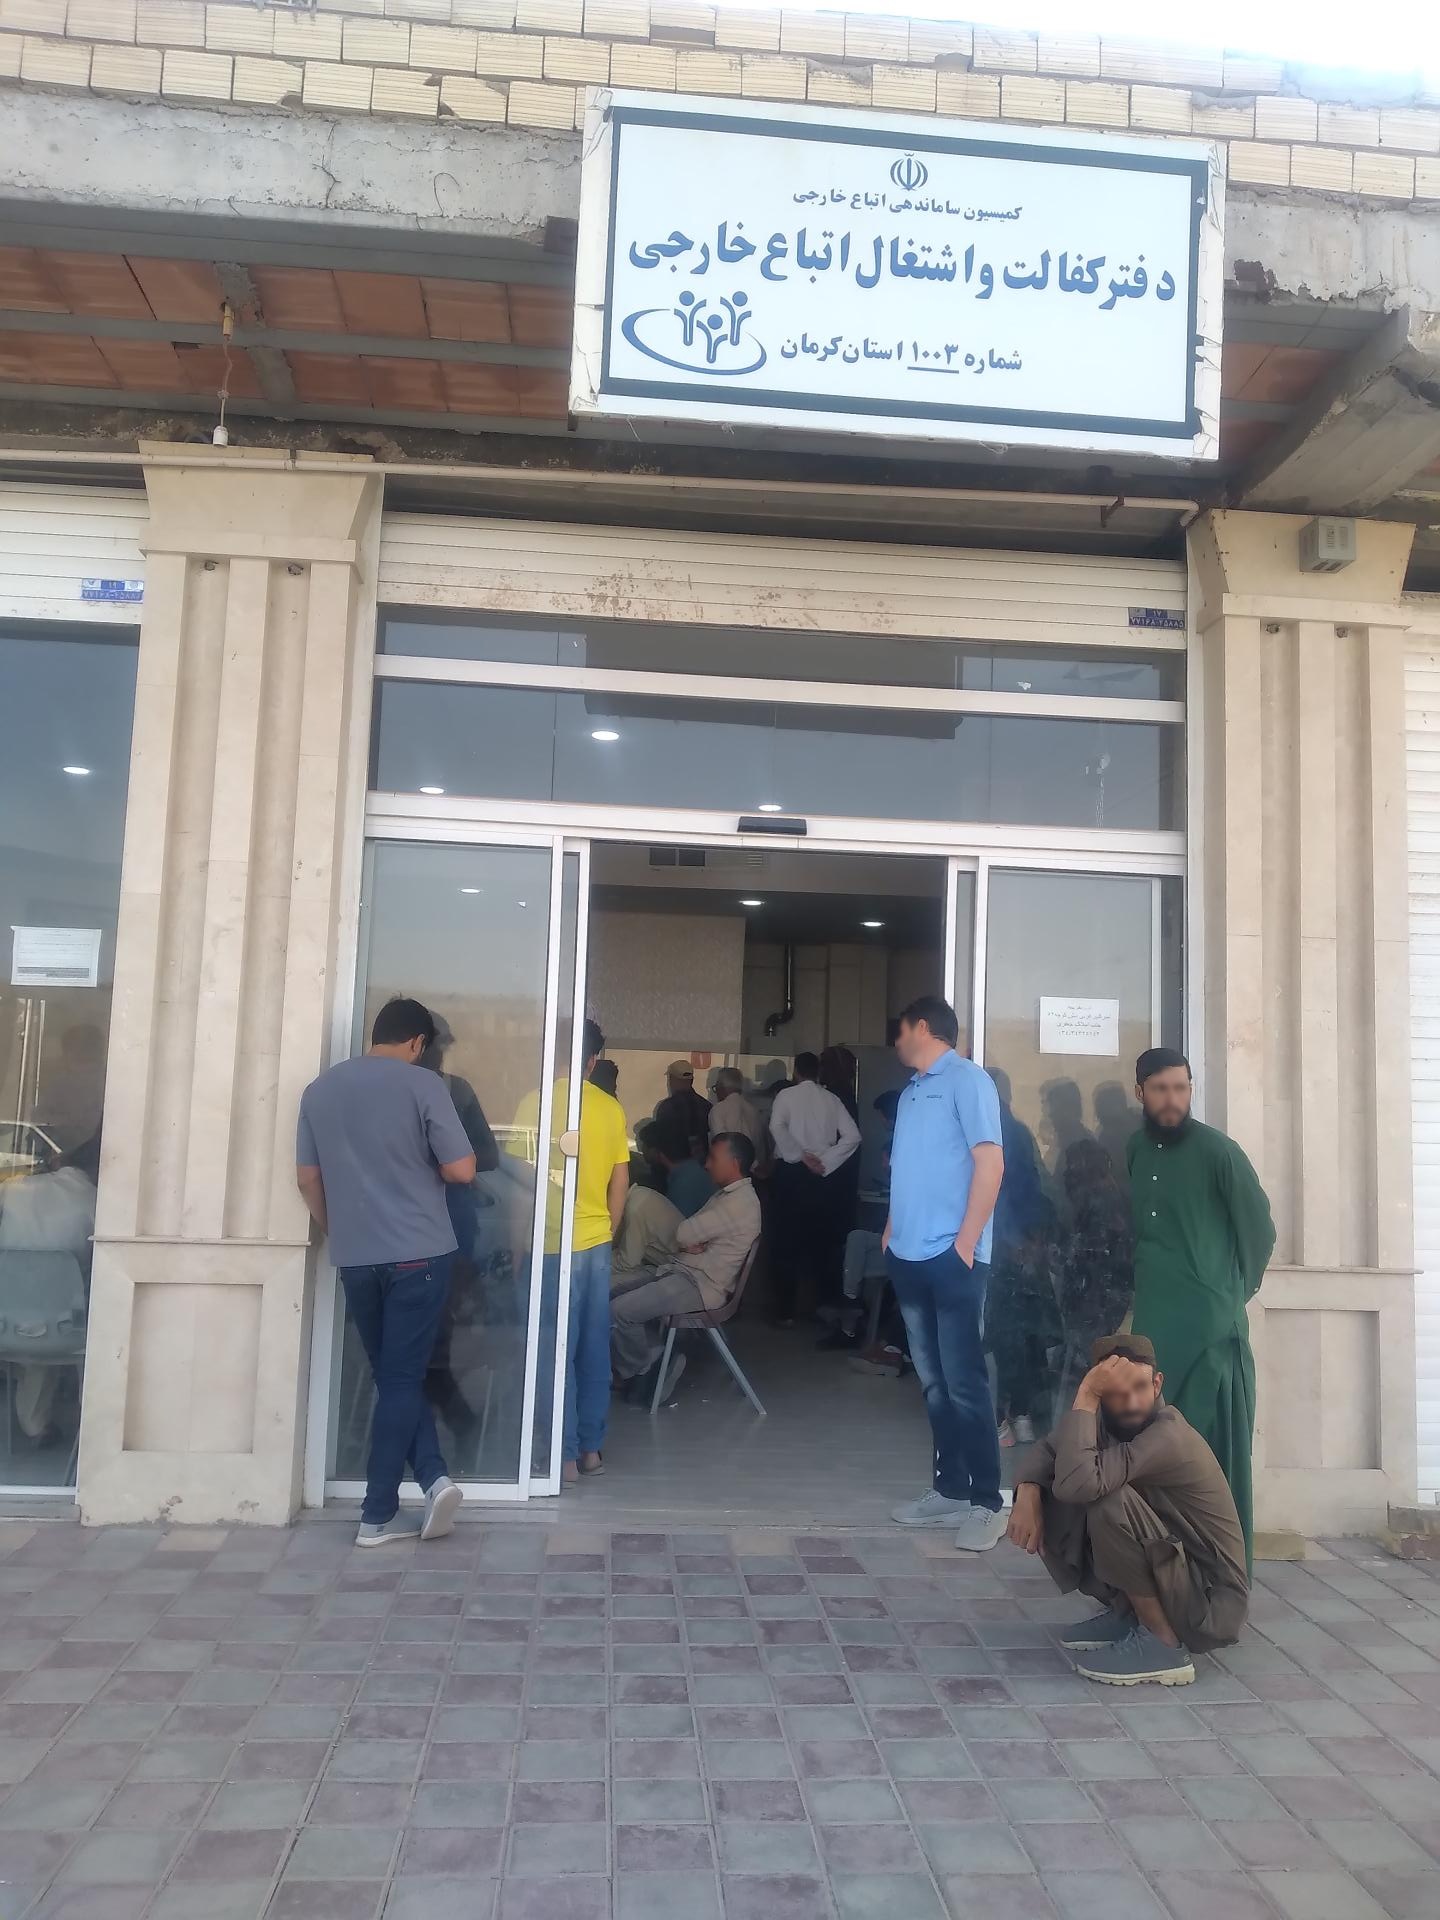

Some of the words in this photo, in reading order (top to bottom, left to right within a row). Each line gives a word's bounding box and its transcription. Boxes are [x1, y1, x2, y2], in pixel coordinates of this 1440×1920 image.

[792, 187, 847, 206] خارجی
[850, 192, 887, 210] اتباع
[889, 197, 961, 214] ساماندهی
[963, 206, 1023, 222] کمیسیون
[628, 220, 757, 275] خارجی
[760, 227, 851, 284] اتباع
[855, 235, 975, 289] اشتغال
[974, 262, 995, 299] و
[1002, 248, 1106, 295] کفالت
[1098, 253, 1176, 310] دفتر
[780, 332, 844, 362] کرمان
[842, 337, 904, 364] استان
[911, 340, 959, 366] ۱۰۰۳
[964, 347, 1023, 375] شماره
